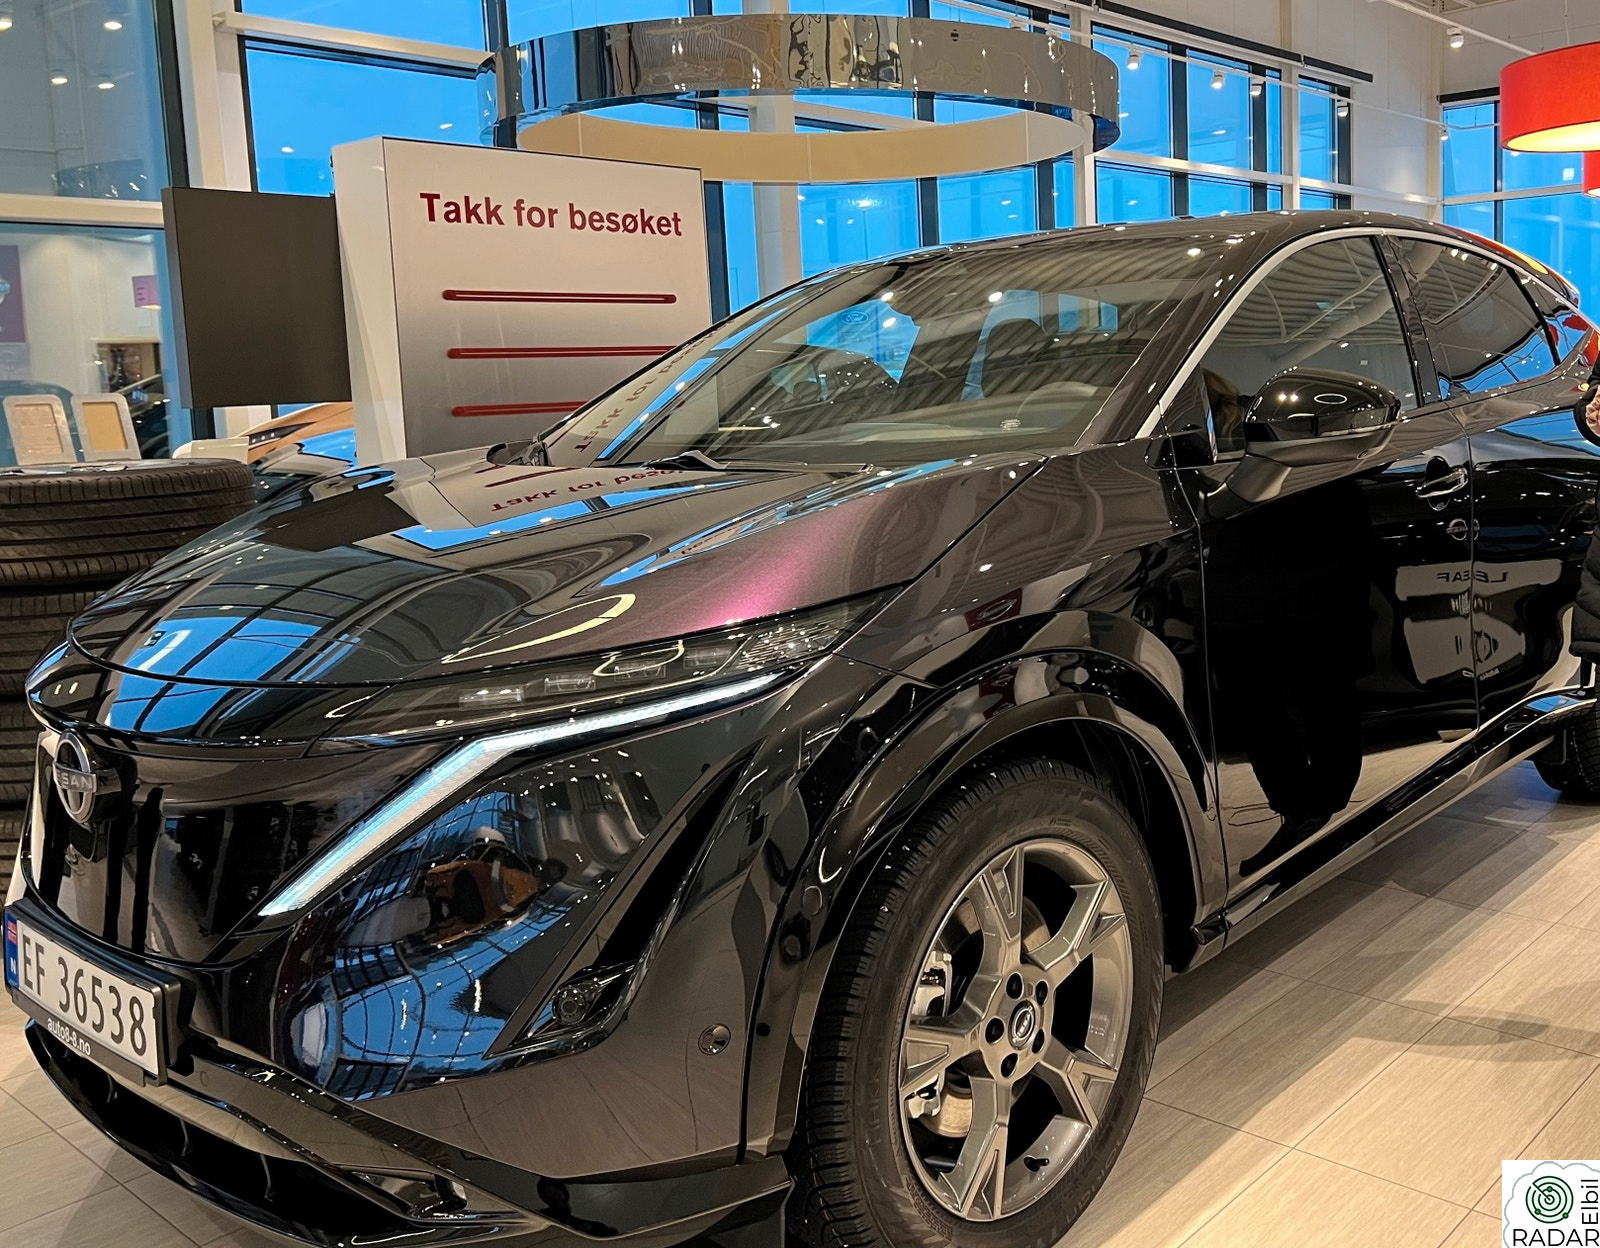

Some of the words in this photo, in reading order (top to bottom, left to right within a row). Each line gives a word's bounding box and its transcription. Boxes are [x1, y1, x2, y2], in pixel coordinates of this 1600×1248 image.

[419, 192, 505, 226] Takk
[513, 199, 559, 229] for
[568, 202, 682, 237] besøket
[22, 934, 46, 997] EF
[57, 956, 147, 1057] 36538
[47, 1017, 91, 1056] auto8-8.no
